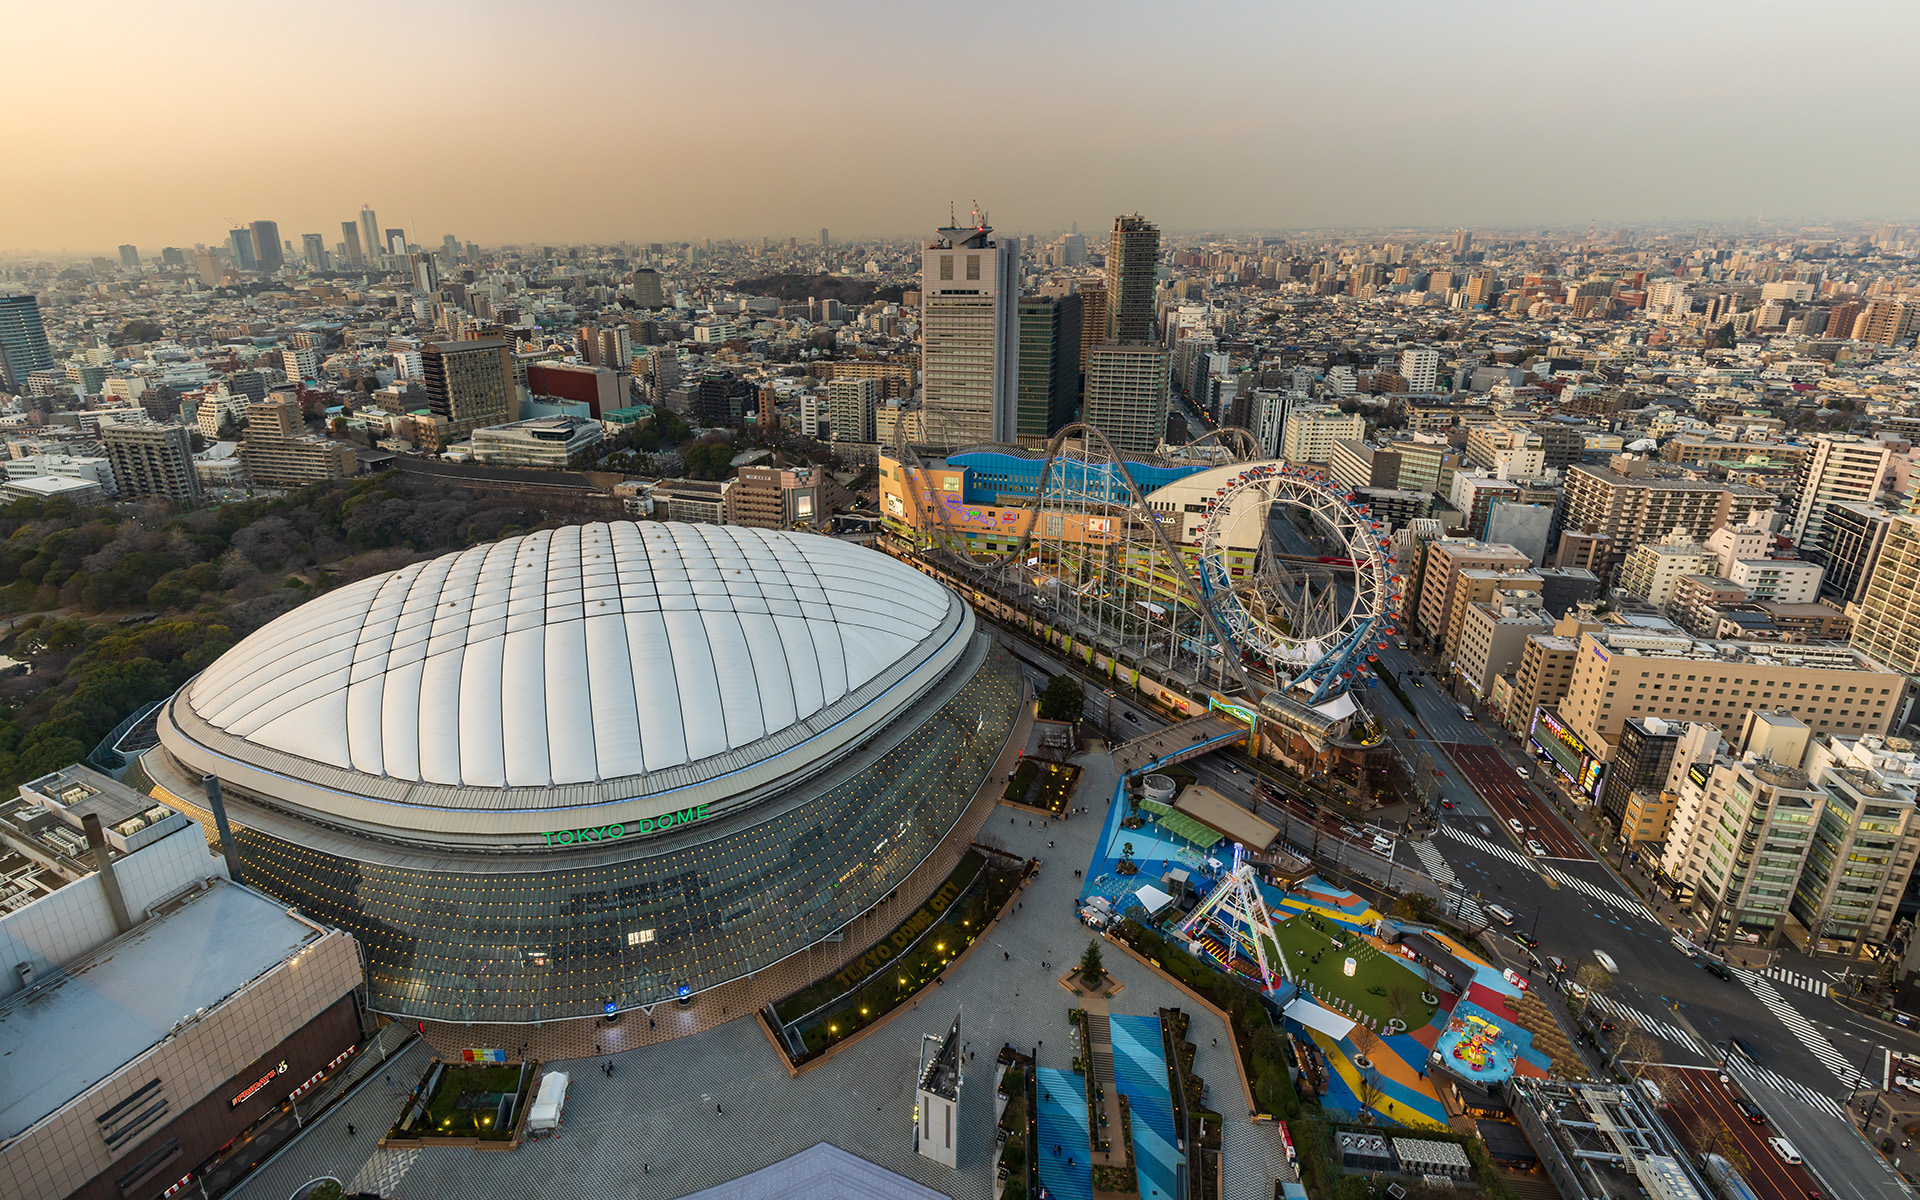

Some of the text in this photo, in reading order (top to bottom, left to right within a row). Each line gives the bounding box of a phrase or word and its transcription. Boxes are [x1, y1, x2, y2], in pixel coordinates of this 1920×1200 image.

[541, 803, 711, 846] TOKYO DOME
[834, 881, 961, 988] TOKYO DOME CITY
